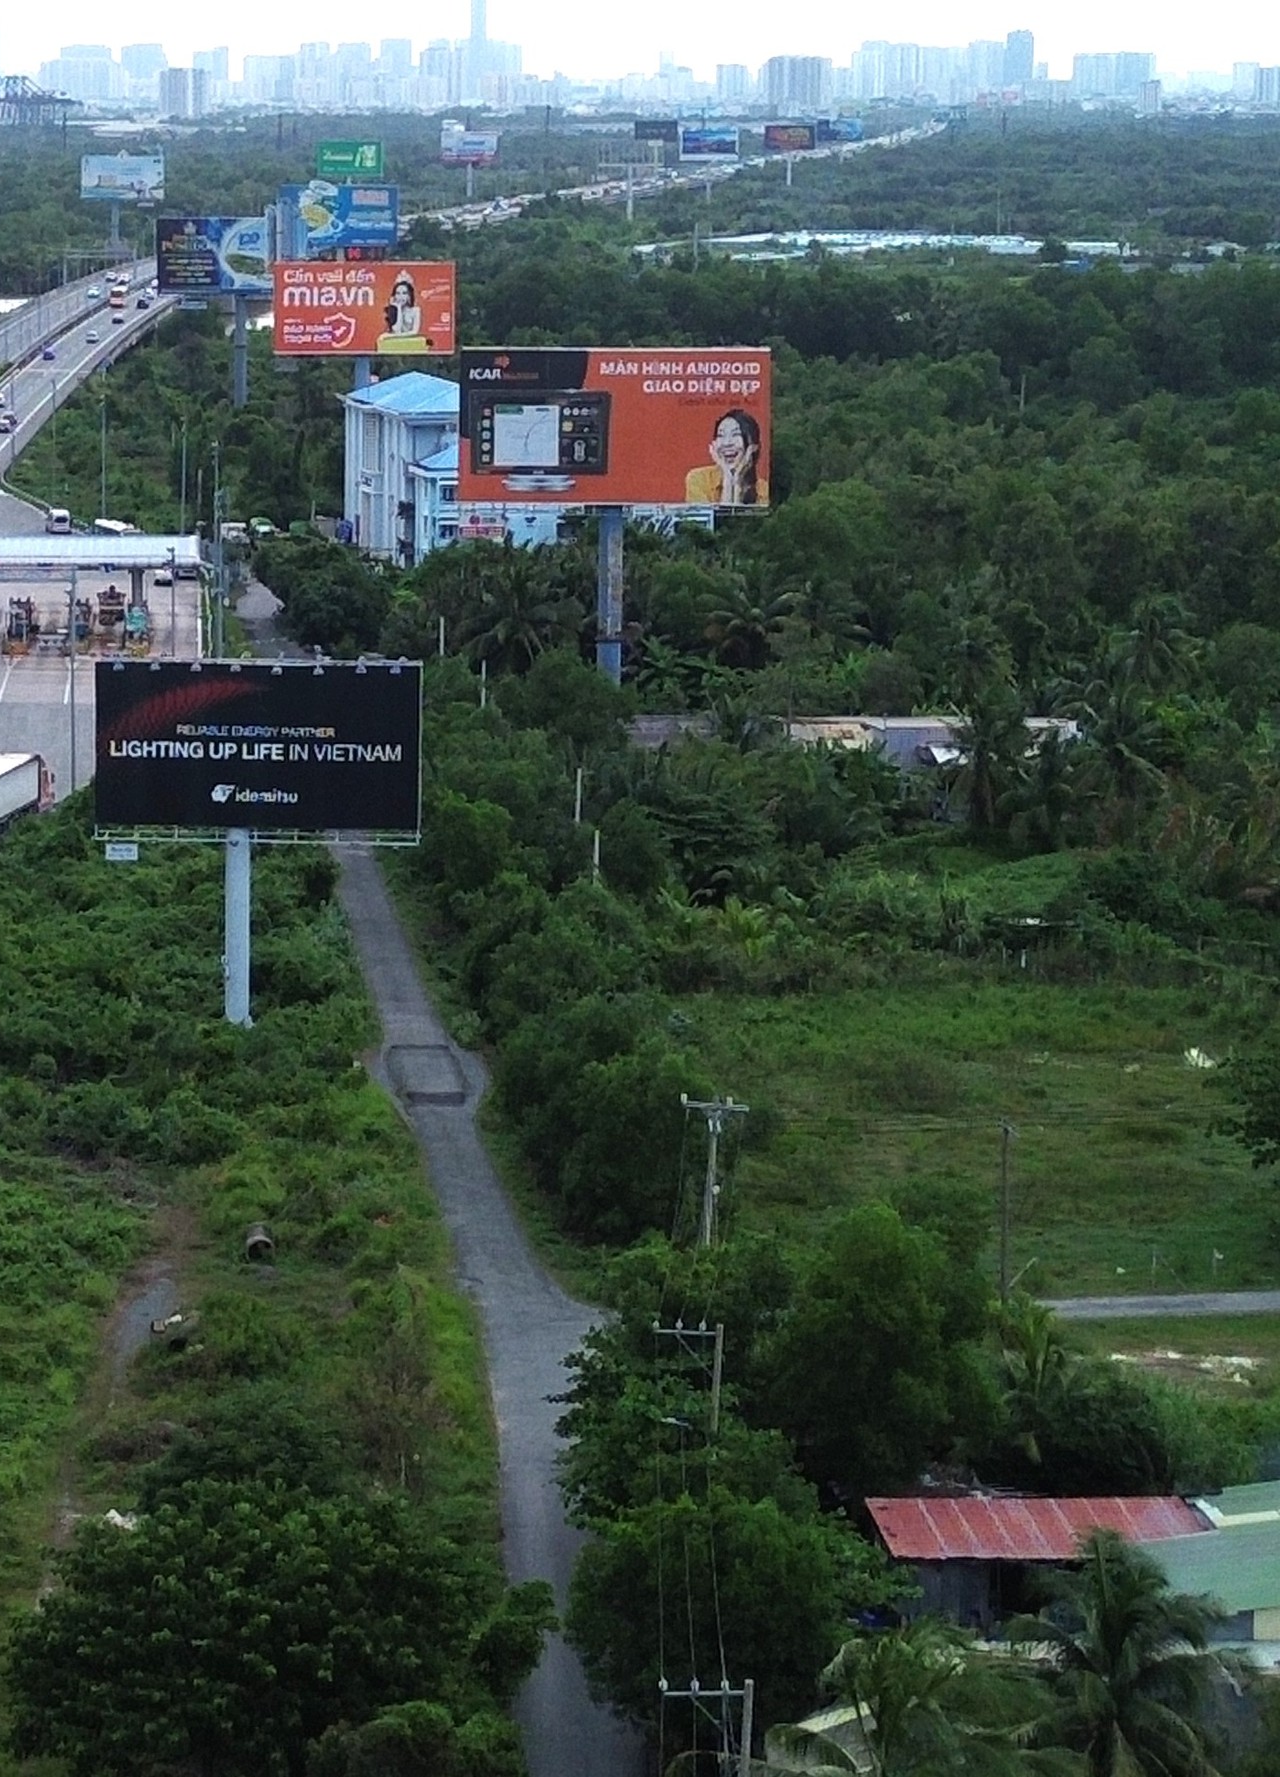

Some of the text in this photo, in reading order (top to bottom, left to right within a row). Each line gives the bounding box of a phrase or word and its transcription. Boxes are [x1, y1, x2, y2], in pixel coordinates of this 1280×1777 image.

[283, 285, 375, 307] mia.vn
[686, 361, 761, 375] ANDROID
[643, 379, 685, 393] GIAO
[280, 726, 336, 738] PARTNER
[109, 740, 402, 762] LIGHTING UP LIFE IN VIETNAM
[234, 786, 299, 804] idemitsu
